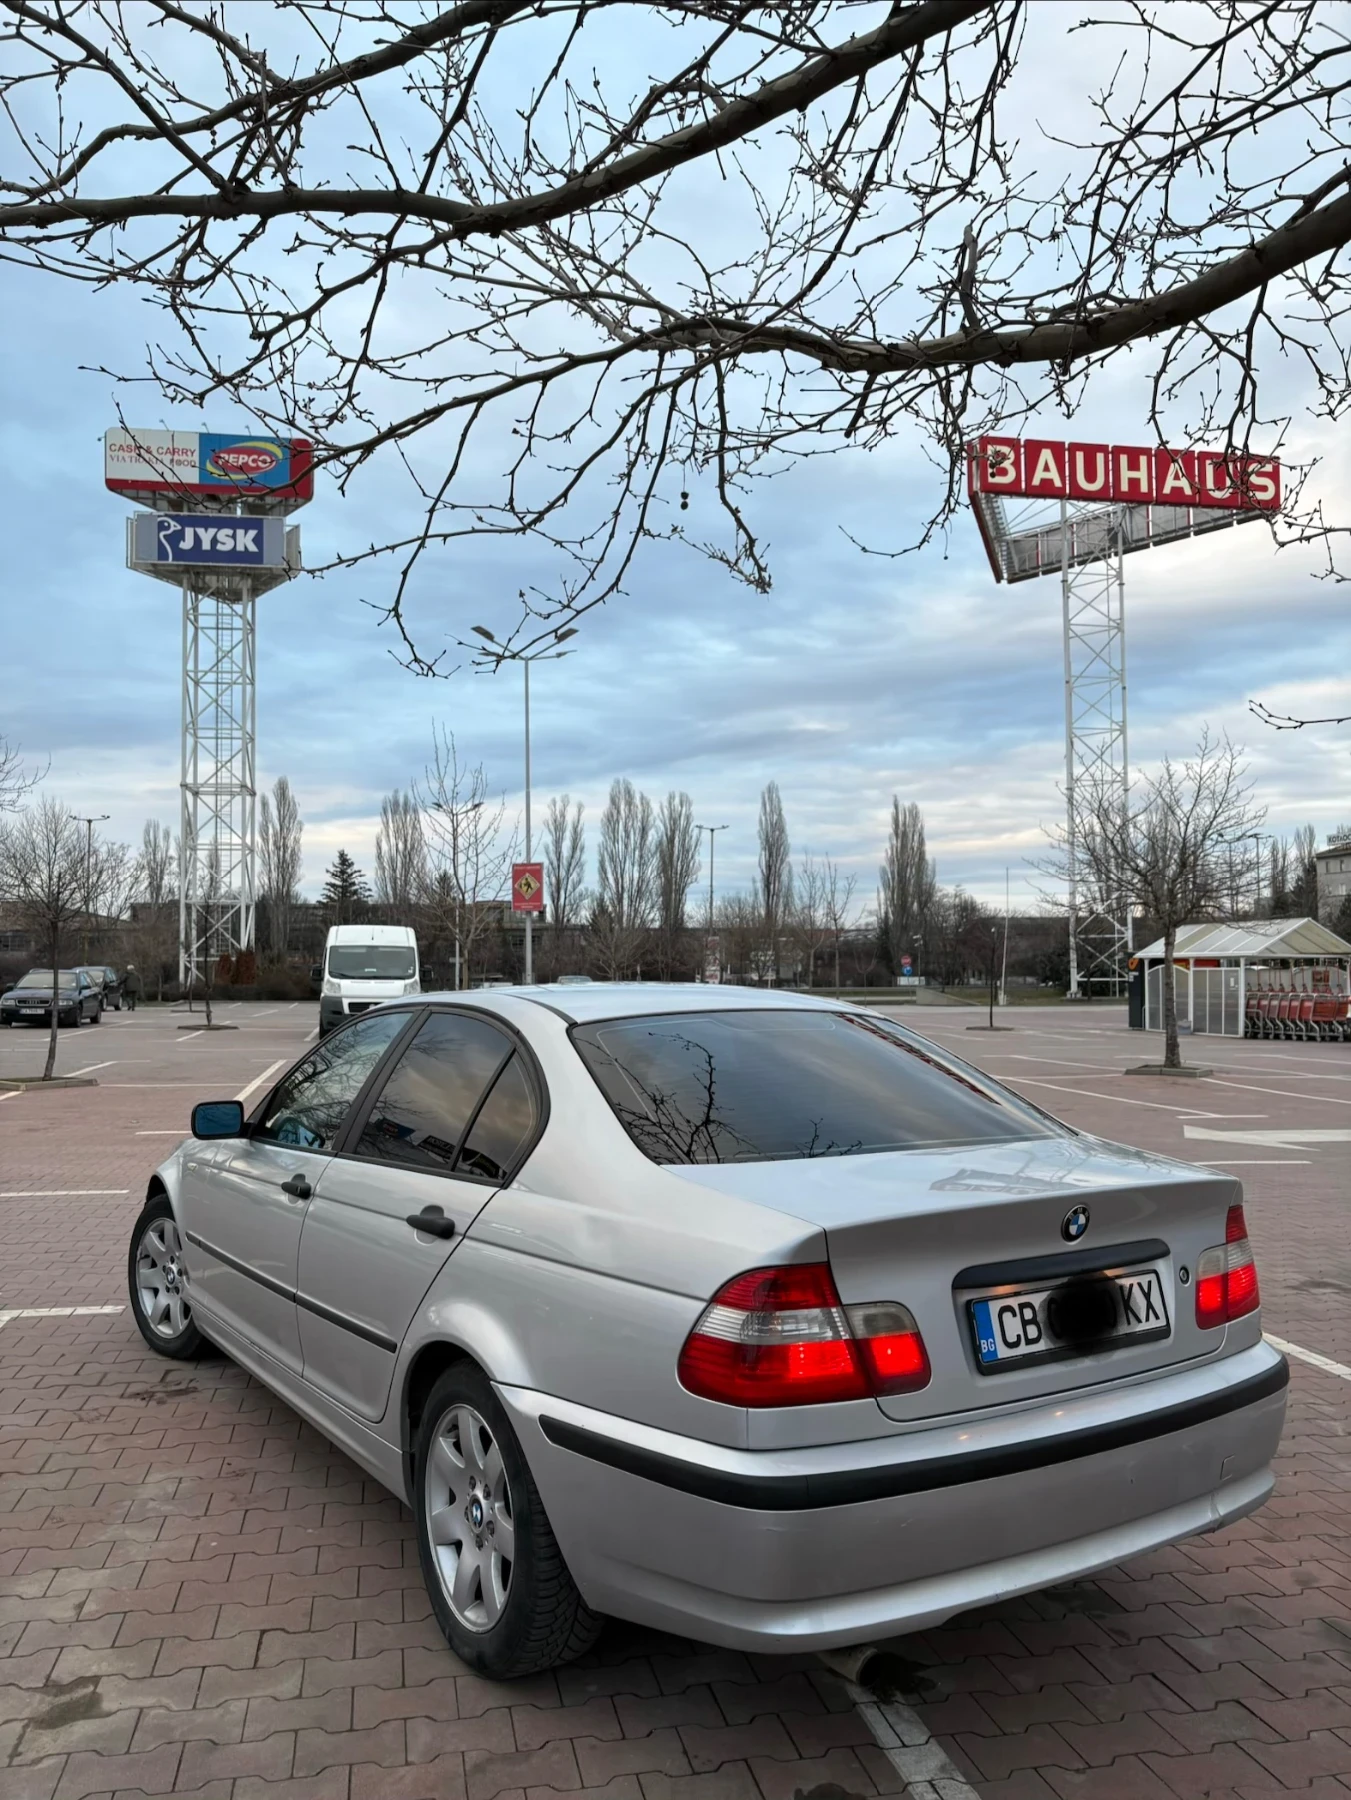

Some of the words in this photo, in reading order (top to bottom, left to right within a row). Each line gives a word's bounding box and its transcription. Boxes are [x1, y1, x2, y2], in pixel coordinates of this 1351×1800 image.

[156, 446, 197, 457] CARRY
[219, 453, 271, 468] PEPCO
[987, 443, 1277, 501] BAUHAUS
[179, 526, 260, 552] JYSK
[997, 1301, 1043, 1350] CB
[1118, 1279, 1161, 1326] KX
[981, 1338, 996, 1353] BG
